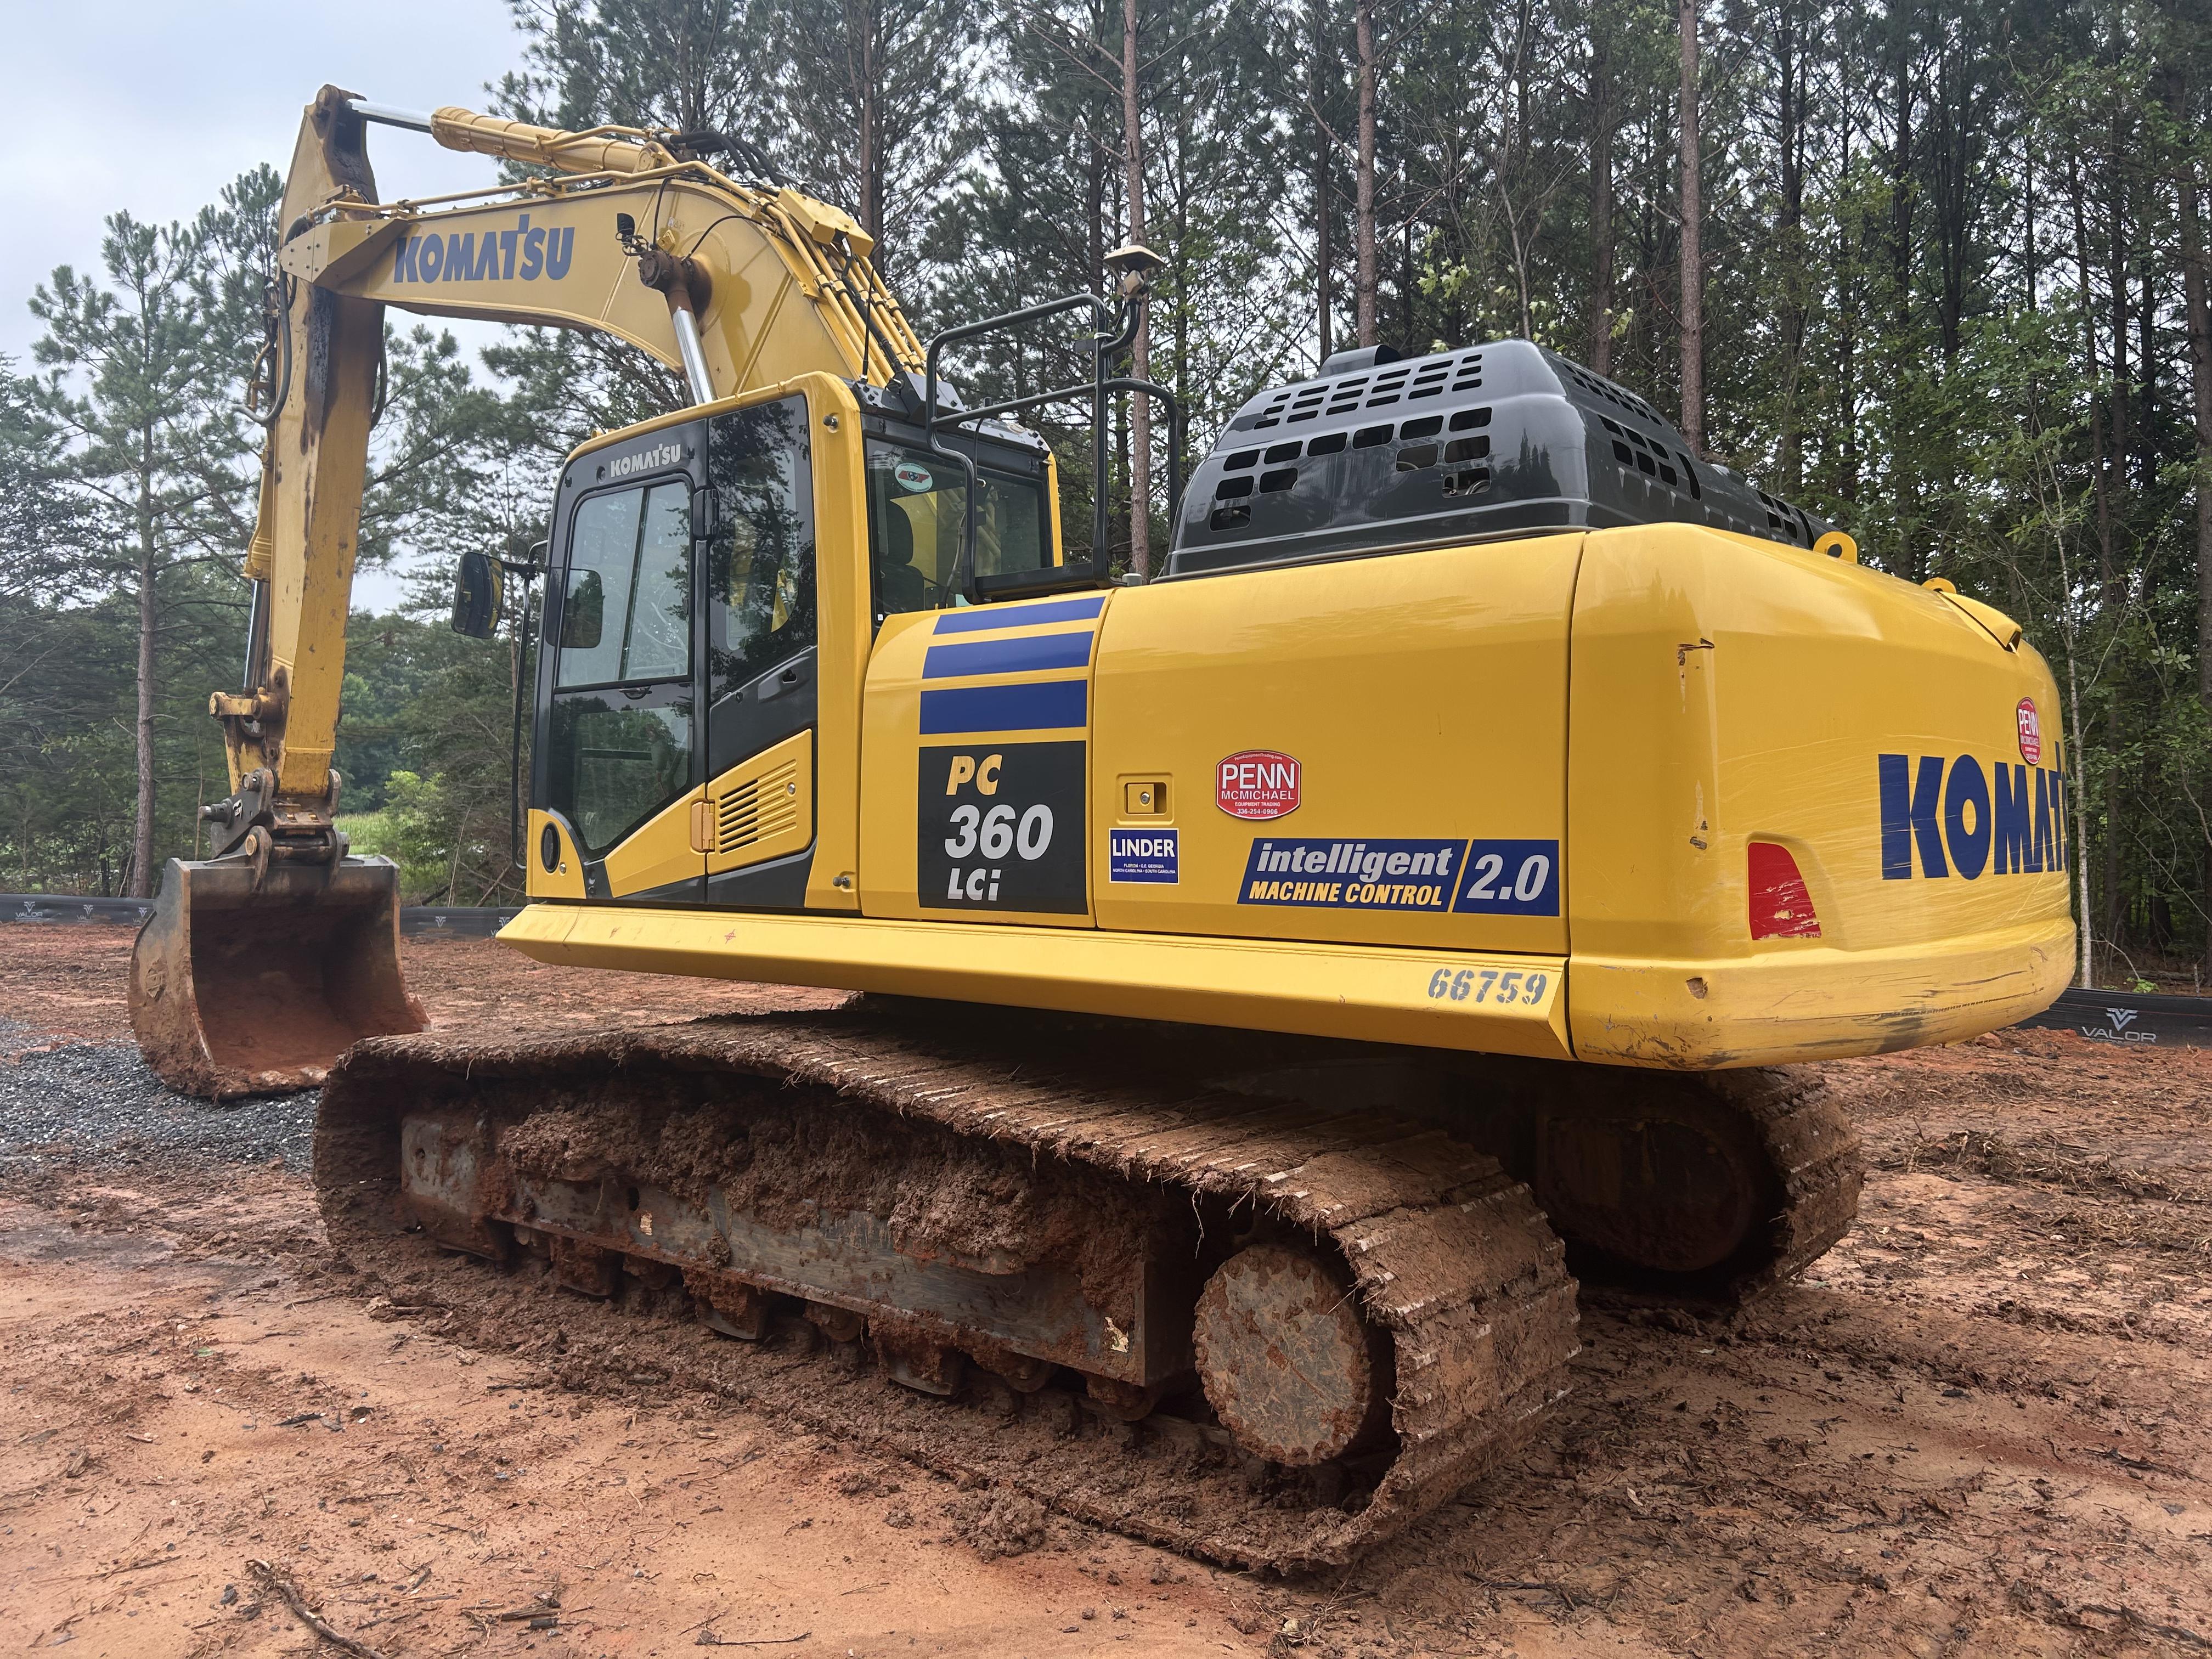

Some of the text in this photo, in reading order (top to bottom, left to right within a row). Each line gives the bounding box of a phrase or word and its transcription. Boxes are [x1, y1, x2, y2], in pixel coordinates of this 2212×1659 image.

[393, 214, 575, 284] KOMATSU
[611, 443, 681, 477] KOMATSU
[2019, 709, 2038, 737] PENN
[946, 754, 1003, 795] PC
[1222, 763, 1295, 789] PENN
[1221, 791, 1295, 800] MCMICHAEL
[944, 804, 1054, 860] 360
[1113, 838, 1175, 857] LINDER
[1256, 843, 1453, 882] intelligent
[1466, 854, 1550, 901] 2.0
[947, 868, 1001, 901] LCi
[1249, 881, 1443, 906] MACHINE CONTROL
[1428, 968, 1548, 1006] 66759
[2081, 1026, 2157, 1042] VALOR
